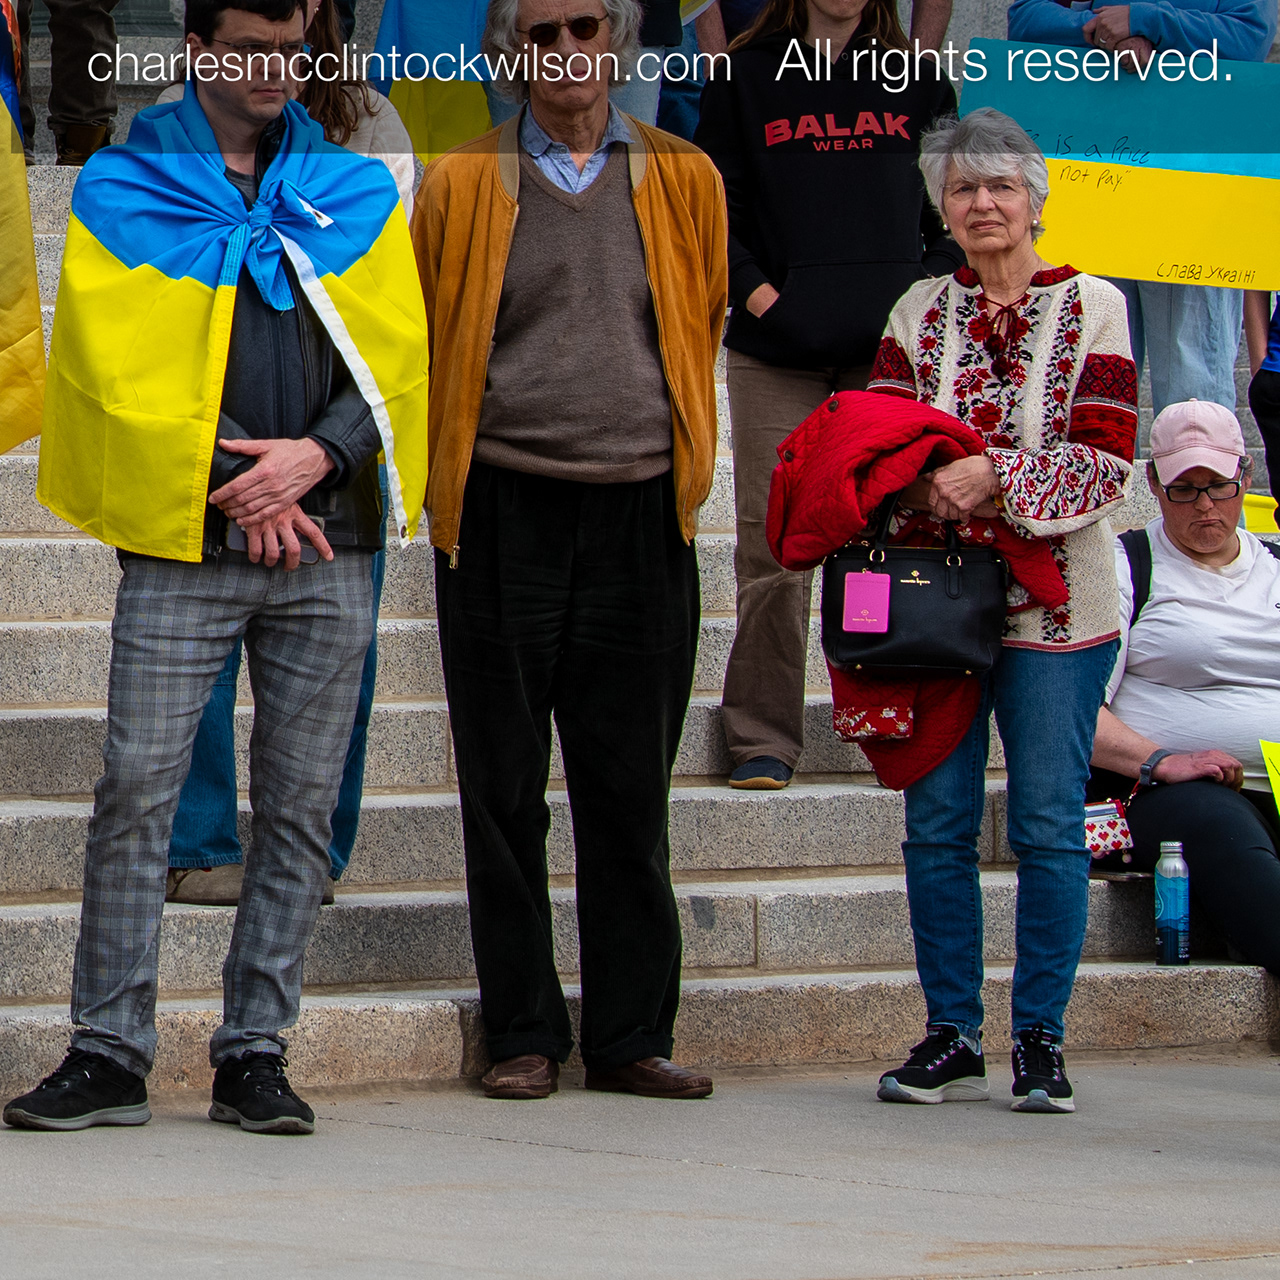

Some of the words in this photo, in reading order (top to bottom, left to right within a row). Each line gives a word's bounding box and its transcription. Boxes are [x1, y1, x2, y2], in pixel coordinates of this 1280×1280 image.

[764, 111, 911, 147] BALAK
[813, 138, 873, 151] WEAR
[1055, 134, 1073, 156] is
[1084, 144, 1102, 158] a
[1060, 166, 1090, 183] not
